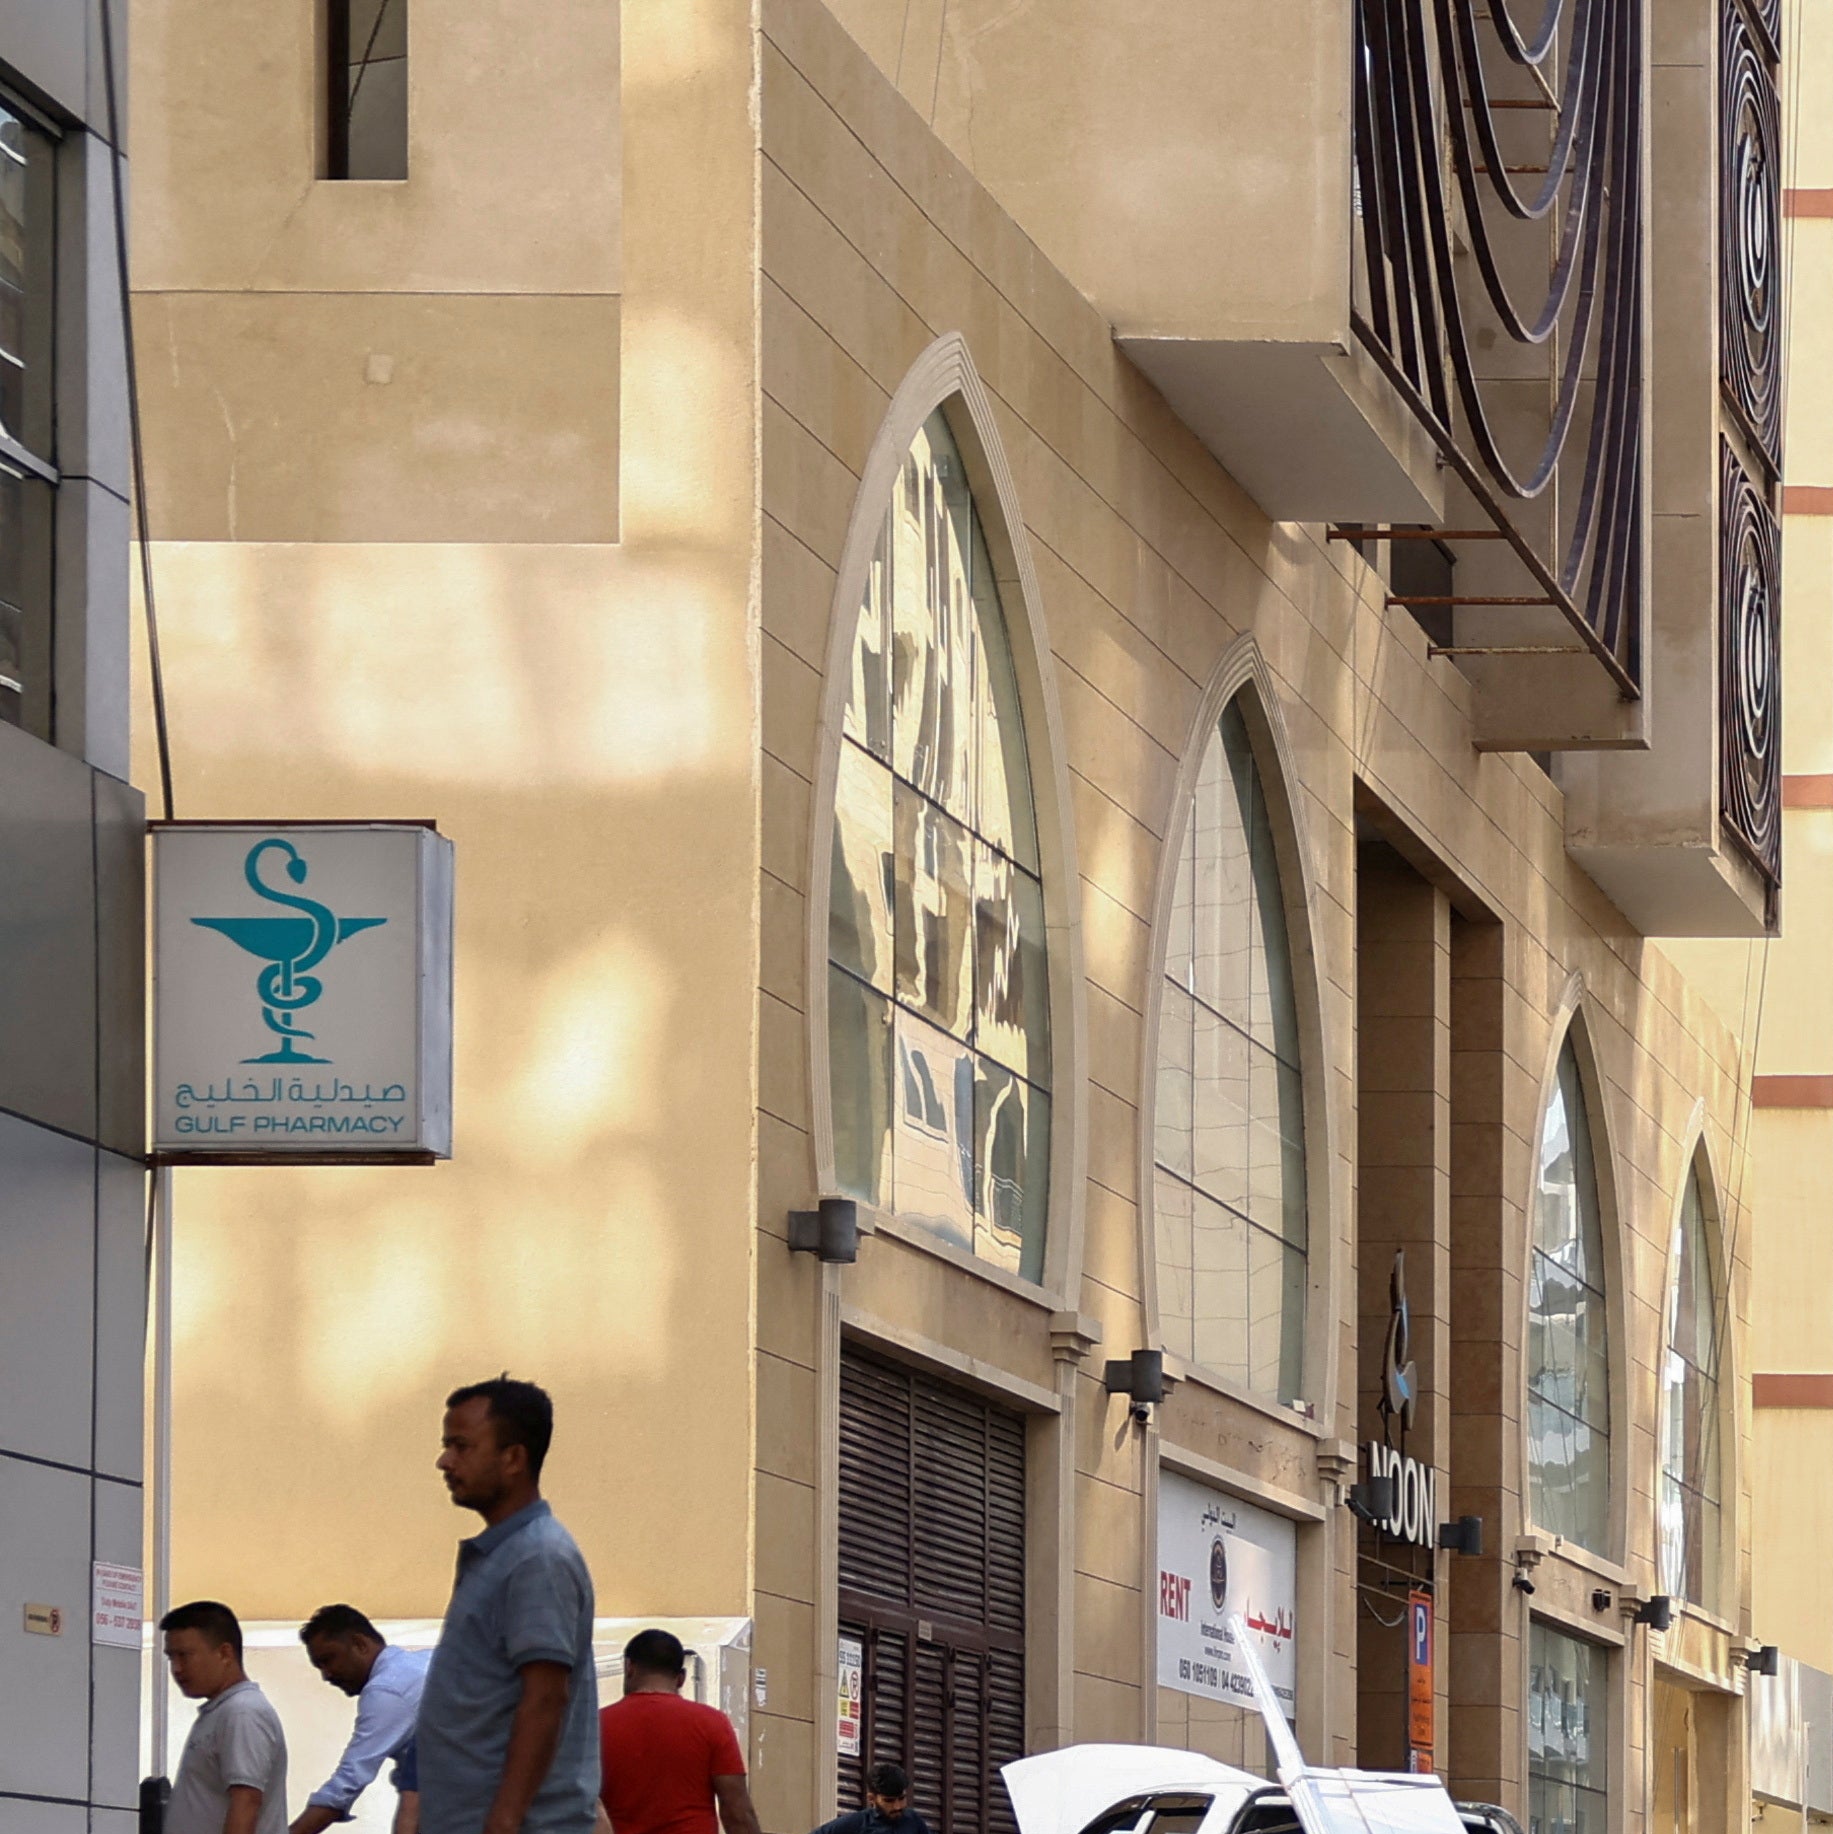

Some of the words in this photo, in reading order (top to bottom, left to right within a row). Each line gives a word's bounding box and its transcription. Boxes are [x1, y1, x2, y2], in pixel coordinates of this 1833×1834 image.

[174, 1077, 283, 1109] الخليج
[288, 1077, 406, 1109] صيدلية
[174, 1115, 246, 1133] GULF
[254, 1115, 405, 1133] PHARMACY
[1160, 1571, 1191, 1622] RENT
[1416, 1607, 1426, 1660] P
